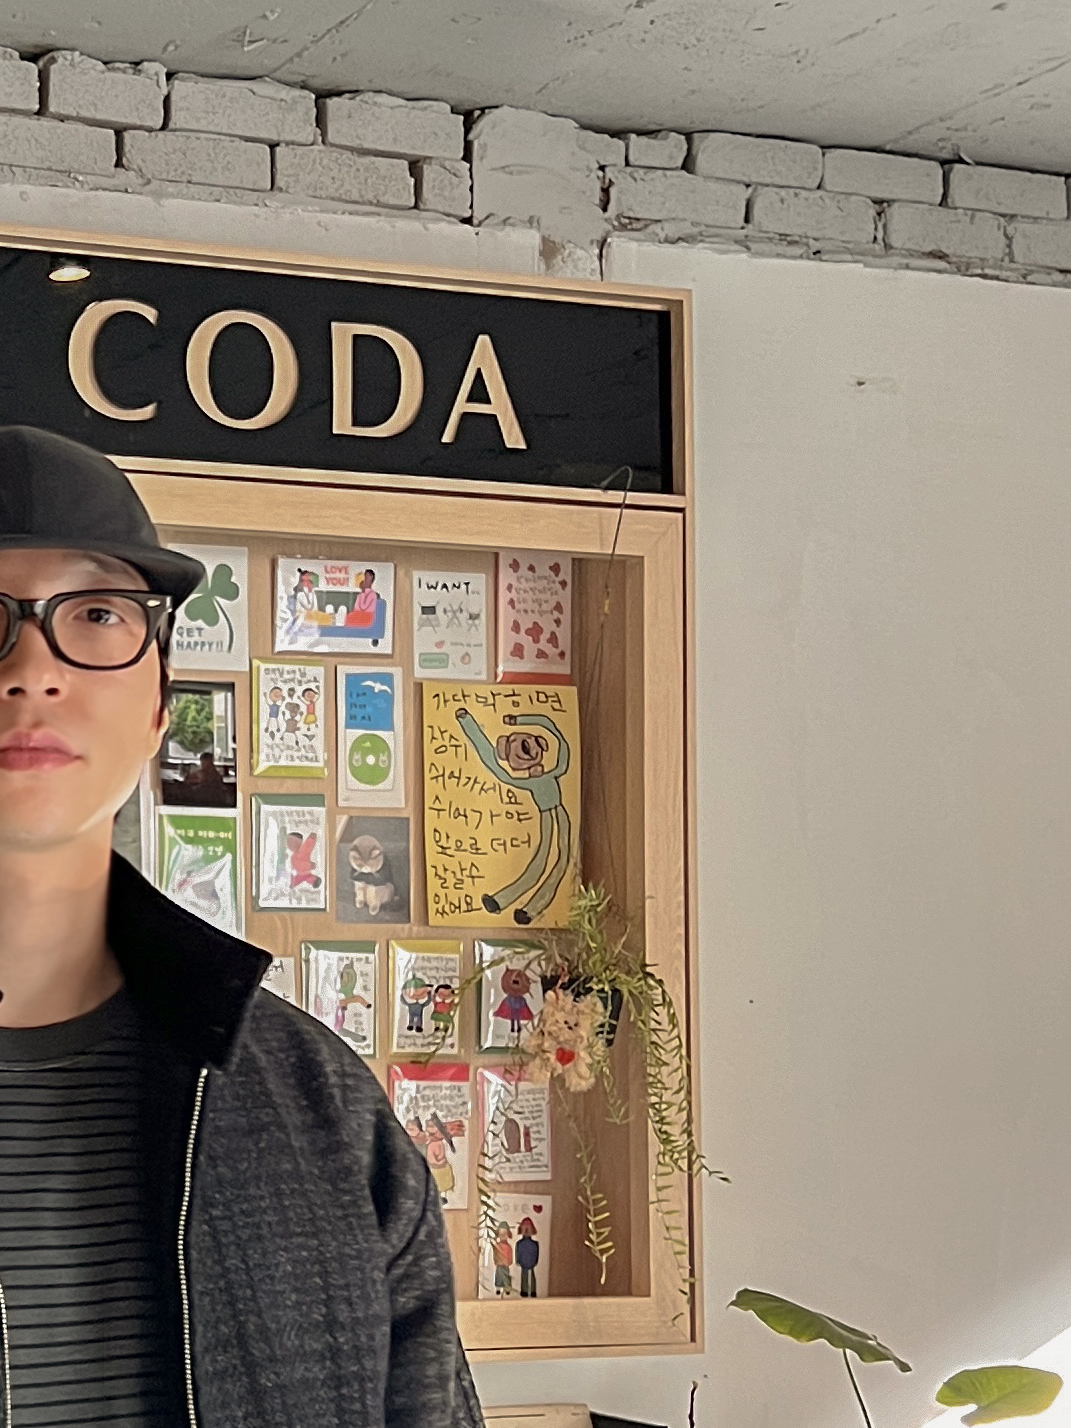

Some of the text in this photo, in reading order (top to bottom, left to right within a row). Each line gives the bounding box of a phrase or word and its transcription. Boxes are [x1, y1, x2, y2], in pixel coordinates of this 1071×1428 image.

[68, 299, 527, 449] CODA
[324, 565, 349, 575] LOVE
[325, 575, 350, 587] YOU!
[418, 577, 422, 589] I
[176, 626, 205, 638] GET
[176, 640, 224, 652] HAPPY!!
[433, 892, 483, 918] 있어요
